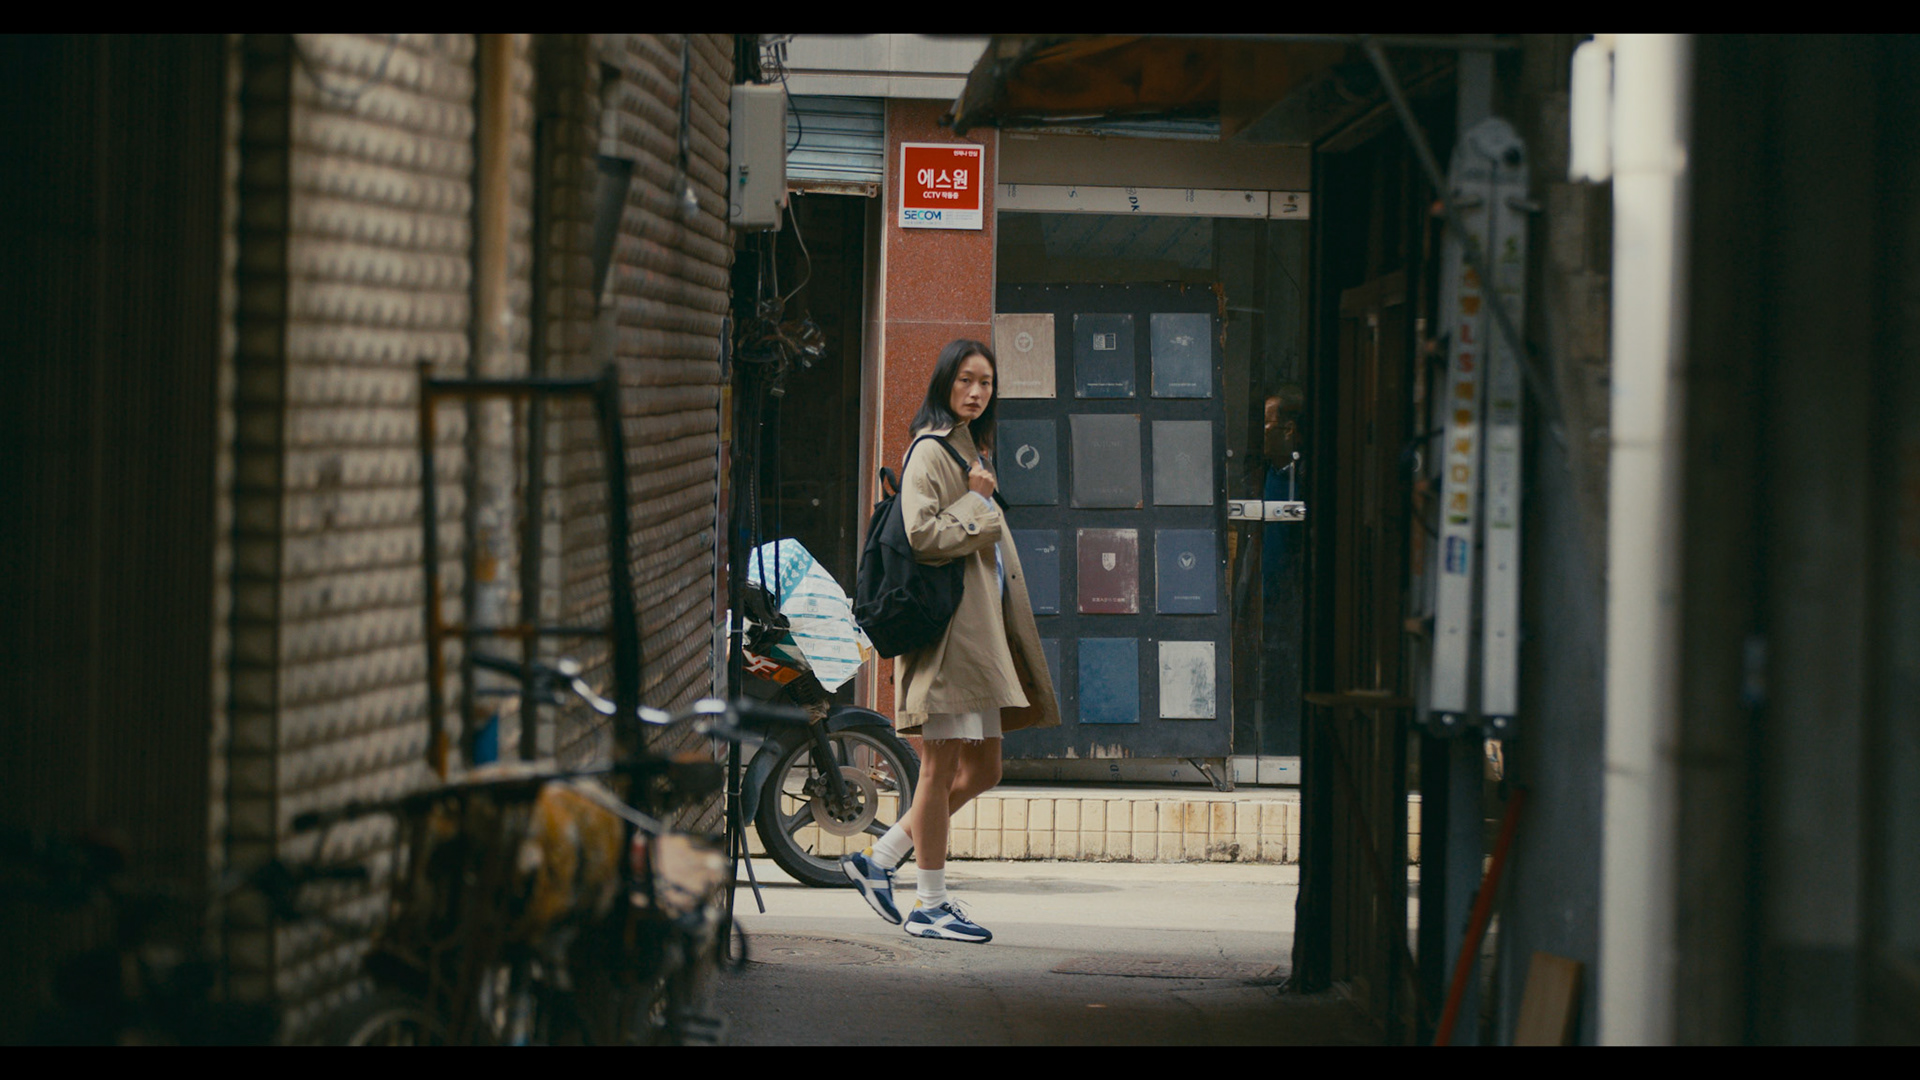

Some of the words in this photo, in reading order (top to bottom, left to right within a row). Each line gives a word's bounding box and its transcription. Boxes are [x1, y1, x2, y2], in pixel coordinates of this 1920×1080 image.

[917, 168, 968, 190] 에스원
[923, 191, 940, 199] CCTV
[904, 210, 942, 221] SECOM
